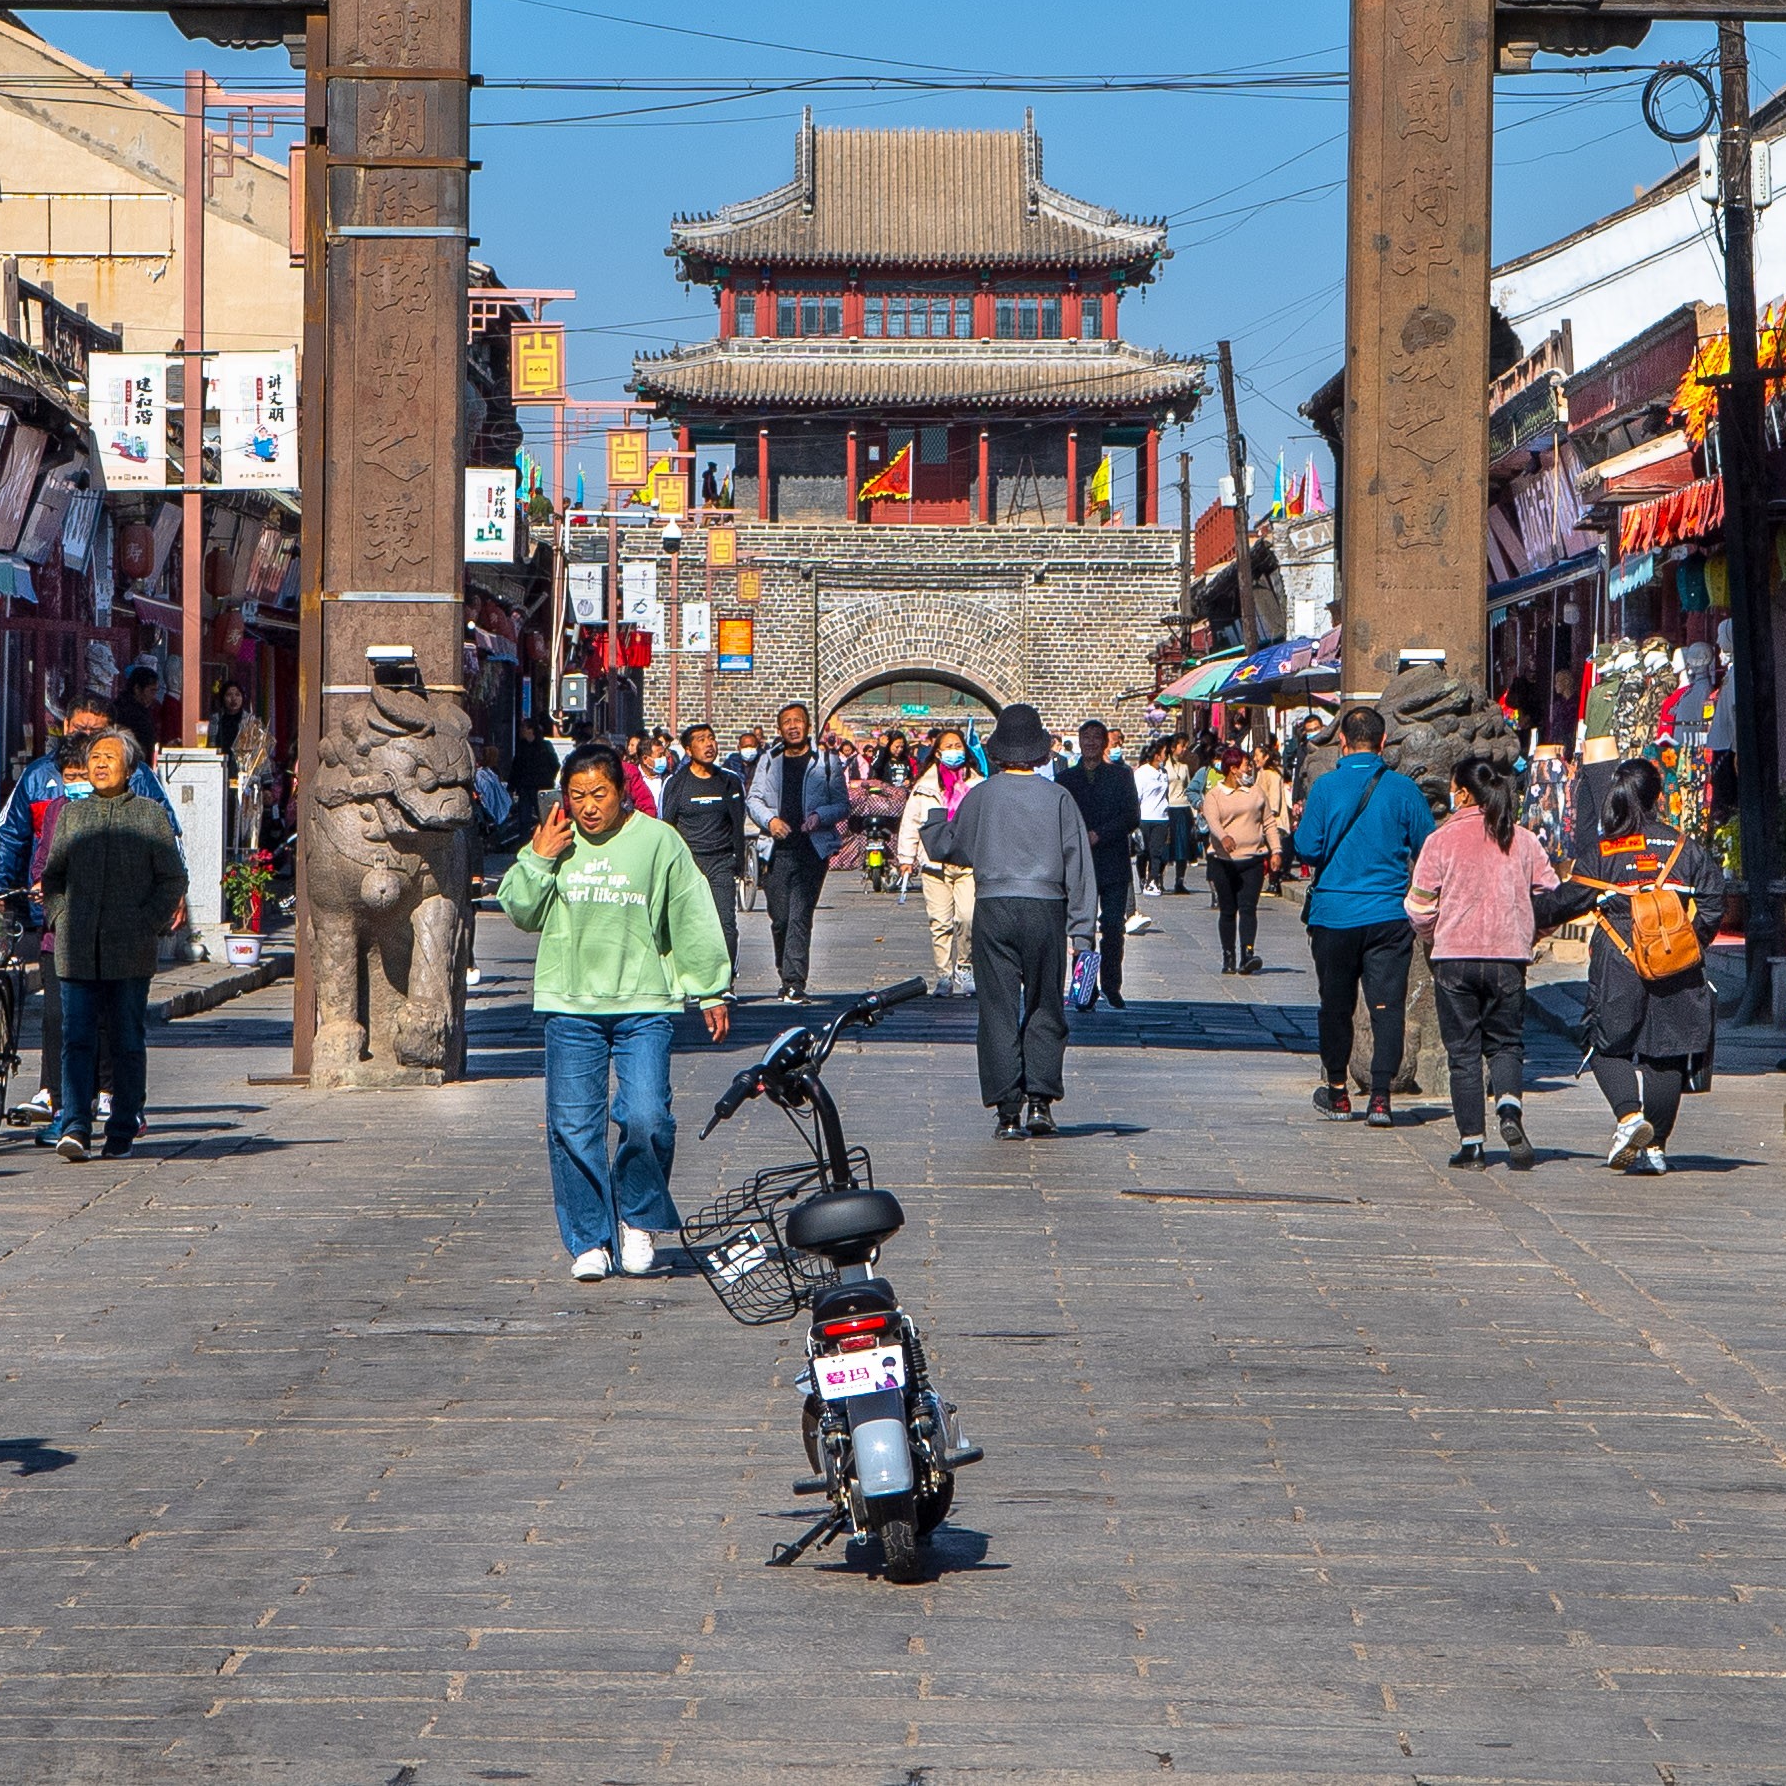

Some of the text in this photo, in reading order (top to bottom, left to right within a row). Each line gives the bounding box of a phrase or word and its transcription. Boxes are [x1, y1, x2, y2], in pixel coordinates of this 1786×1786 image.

[134, 376, 154, 426] 建和谐
[266, 374, 285, 423] 讲文明
[566, 870, 631, 889] cheer up.
[592, 886, 620, 903] like
[619, 891, 647, 907] you
